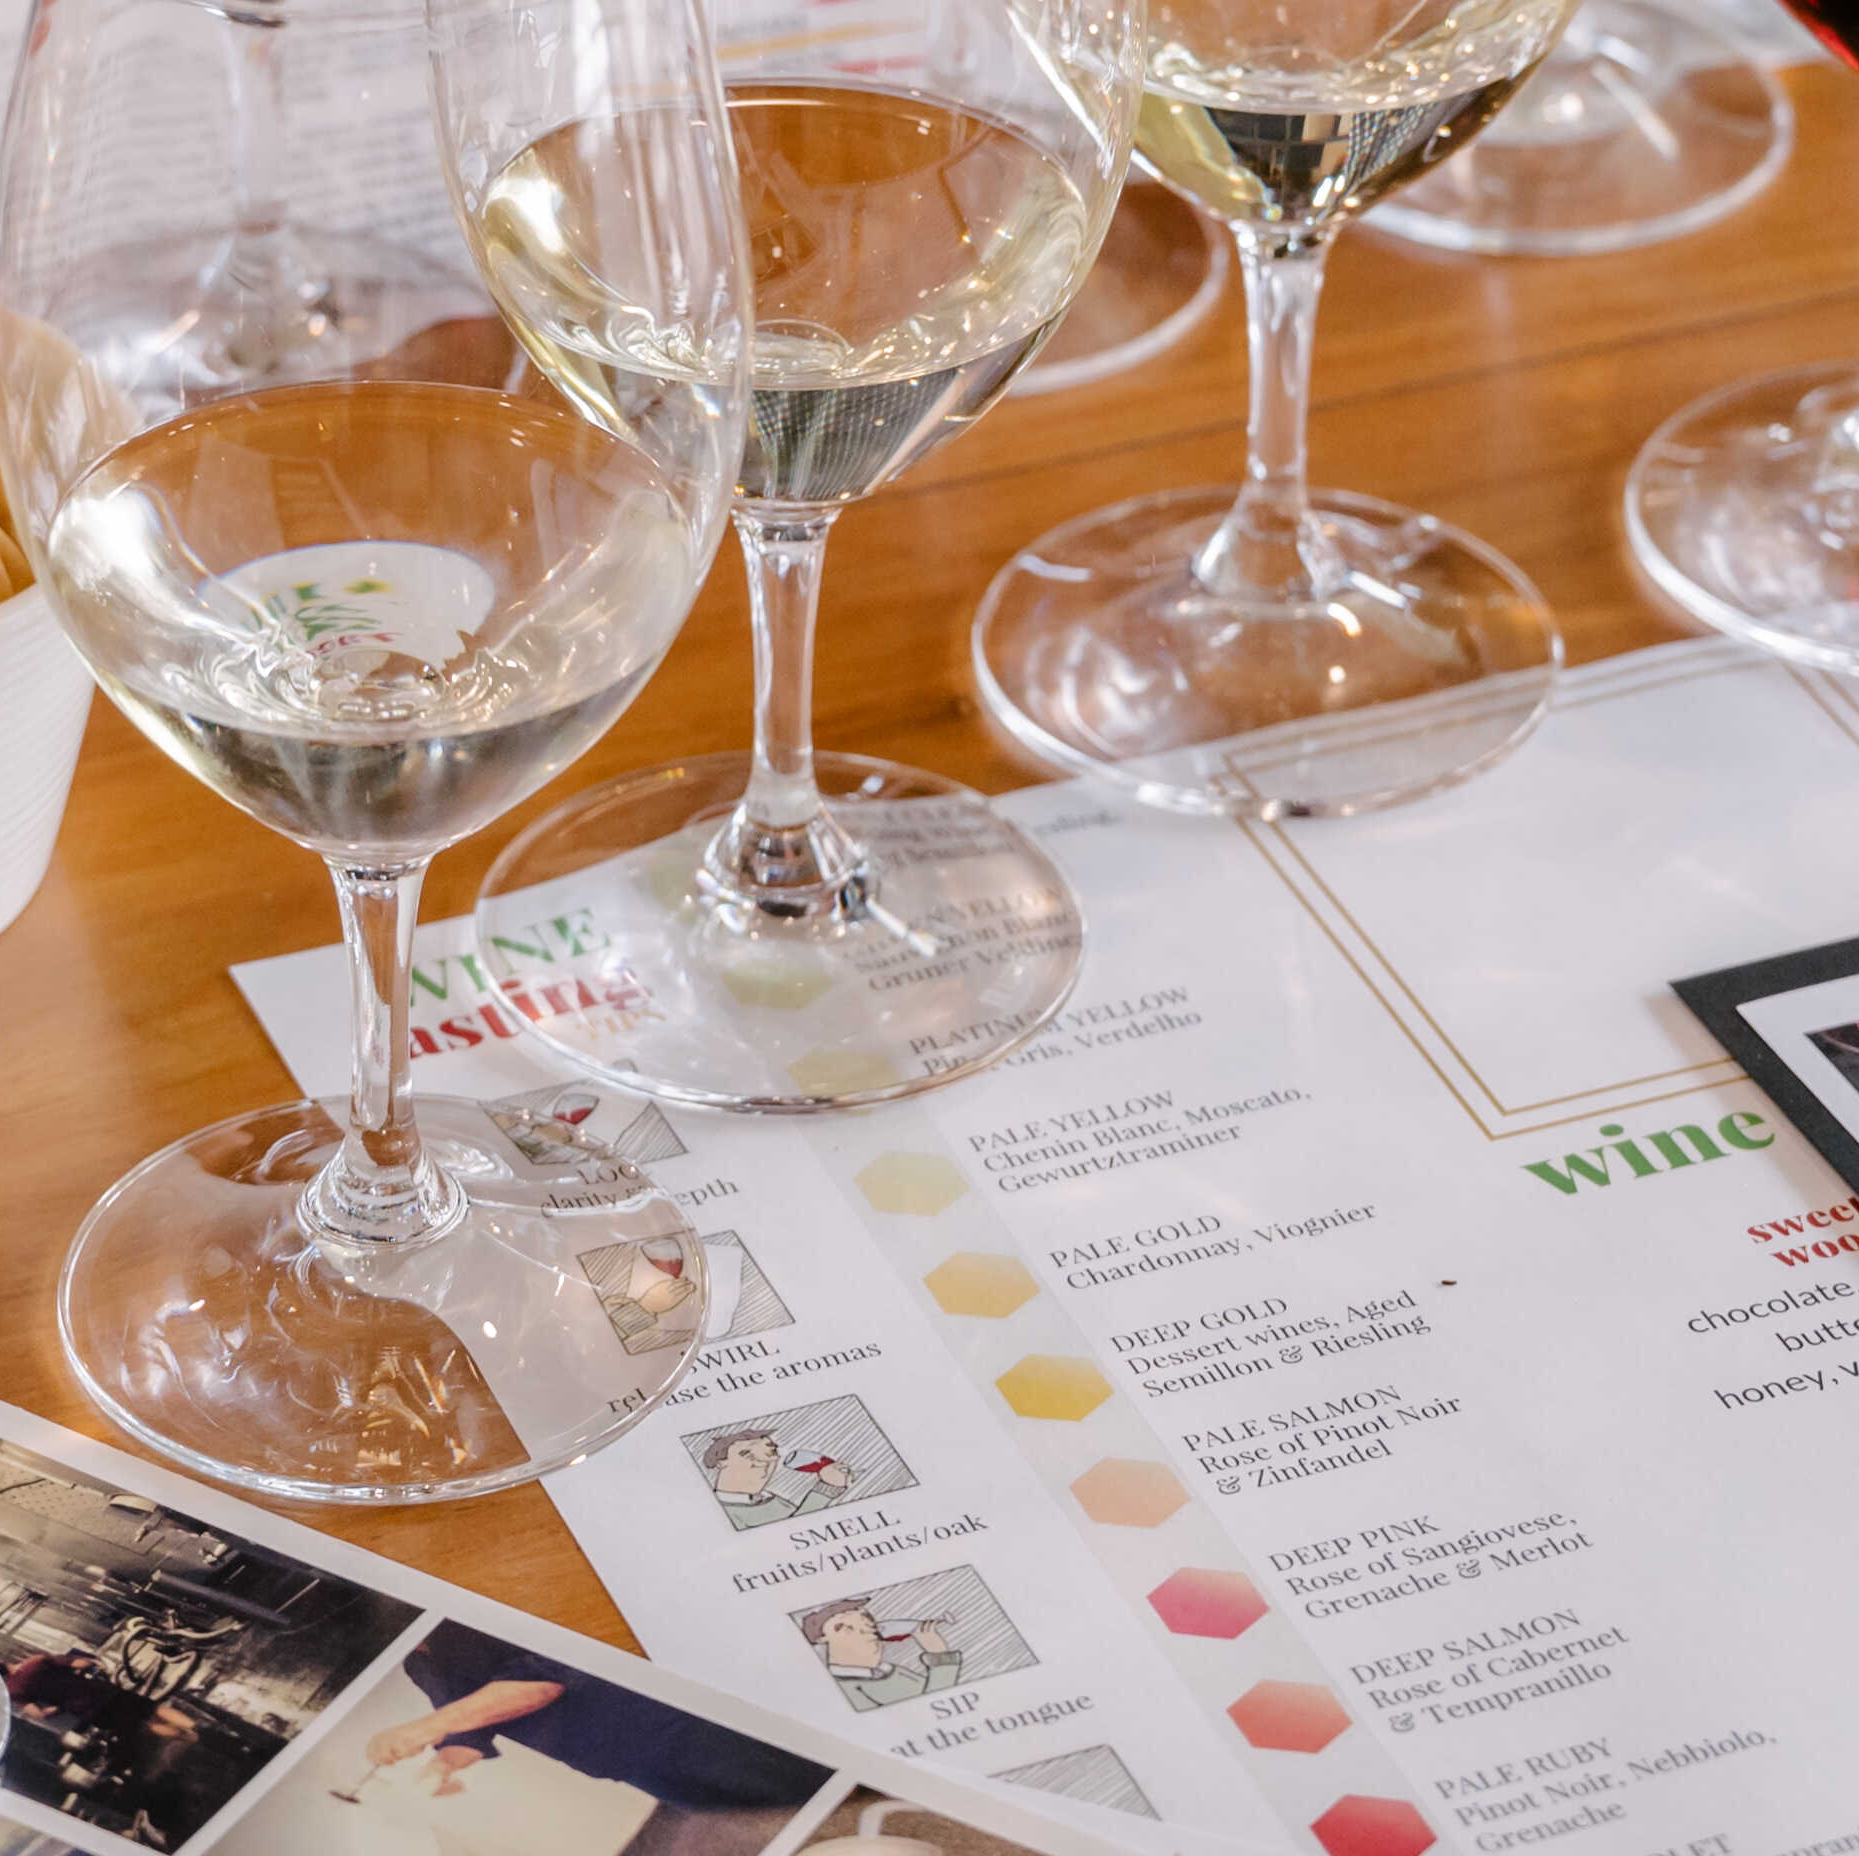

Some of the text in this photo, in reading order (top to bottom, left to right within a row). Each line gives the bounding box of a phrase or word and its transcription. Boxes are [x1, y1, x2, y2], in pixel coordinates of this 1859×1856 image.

[410, 974, 654, 1060] asting
[1065, 985, 1191, 1030] YELLOW
[1073, 1009, 1203, 1050] Verdelho
[968, 1090, 1174, 1154] PALE YELLOW
[983, 1086, 1313, 1174] Chenin Blanc, Moscato,
[1520, 1110, 1777, 1196] wine
[577, 1162, 653, 1186] LOO
[671, 1177, 740, 1207] epth
[997, 1124, 1243, 1194] Gewurtztraminer
[1048, 1213, 1223, 1270] PALE GOLD
[1066, 1202, 1378, 1292] Chardonnay, Viognier
[1111, 1296, 1289, 1354] DEEP GOLD
[1126, 1289, 1419, 1376] Dessert wines, Aged
[1141, 1313, 1433, 1398] Semillon & Riesling
[607, 1342, 883, 1415] relase the aromas
[1713, 1369, 1840, 1411] honey,
[1181, 1384, 1404, 1453] PALE SALMON
[1197, 1396, 1464, 1475] Rose of Pinot Noir
[1215, 1438, 1395, 1496] & Zinfandel
[731, 1513, 990, 1594] fruits/plants/oak
[789, 1509, 902, 1552] SMELL
[1267, 1513, 1443, 1573] DEEP PINK
[1285, 1510, 1579, 1597] Rose of Sangiovese,
[1303, 1529, 1597, 1619] Grenache & Merlot
[1348, 1607, 1583, 1686] DEEP SALMON
[1367, 1625, 1631, 1711] Rose of Cabernet
[926, 1725, 980, 1752] the
[984, 1694, 1096, 1735] tongue
[929, 1691, 982, 1721] SIP
[1389, 1660, 1614, 1734] & Tempranillo
[1433, 1736, 1615, 1801] PALE RUBY
[1453, 1727, 1780, 1829] Pinot Noir, Nebbiolo,
[1475, 1799, 1630, 1854] Grenache
